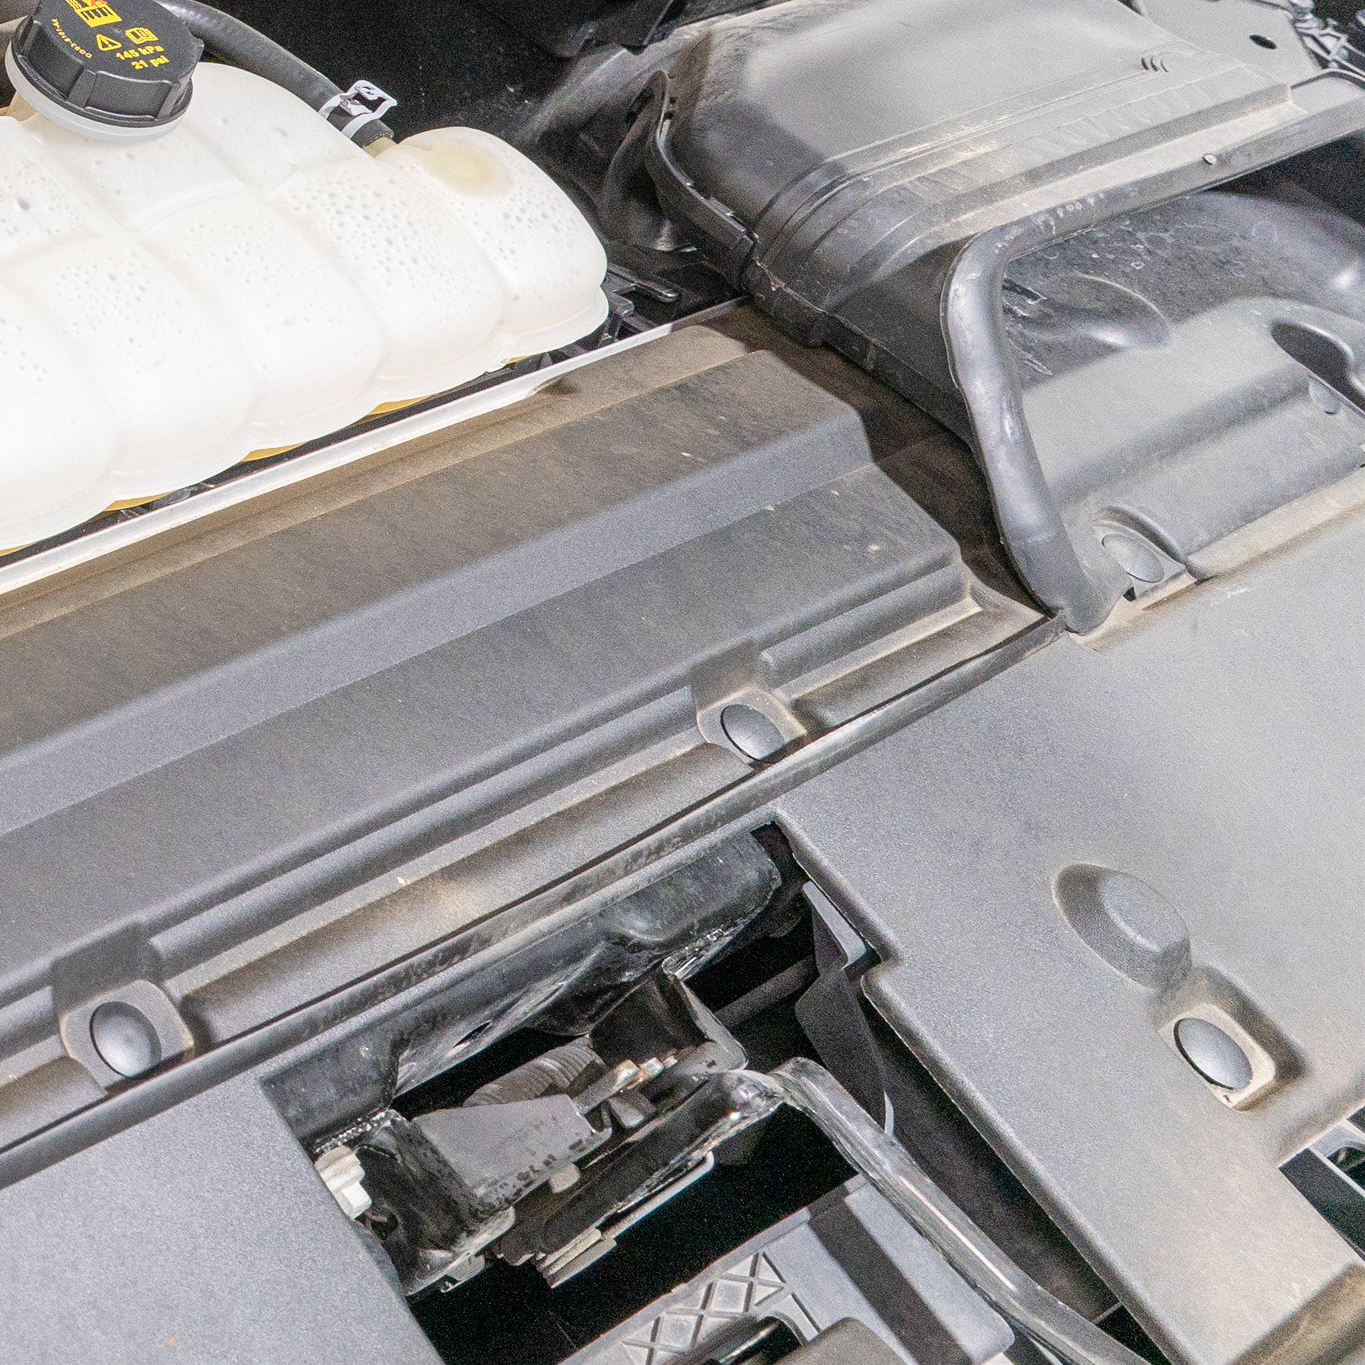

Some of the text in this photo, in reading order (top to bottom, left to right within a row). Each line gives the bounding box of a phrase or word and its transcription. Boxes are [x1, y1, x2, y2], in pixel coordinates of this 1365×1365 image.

[116, 45, 165, 60] 145 kPa
[131, 55, 169, 70] 21 psi
